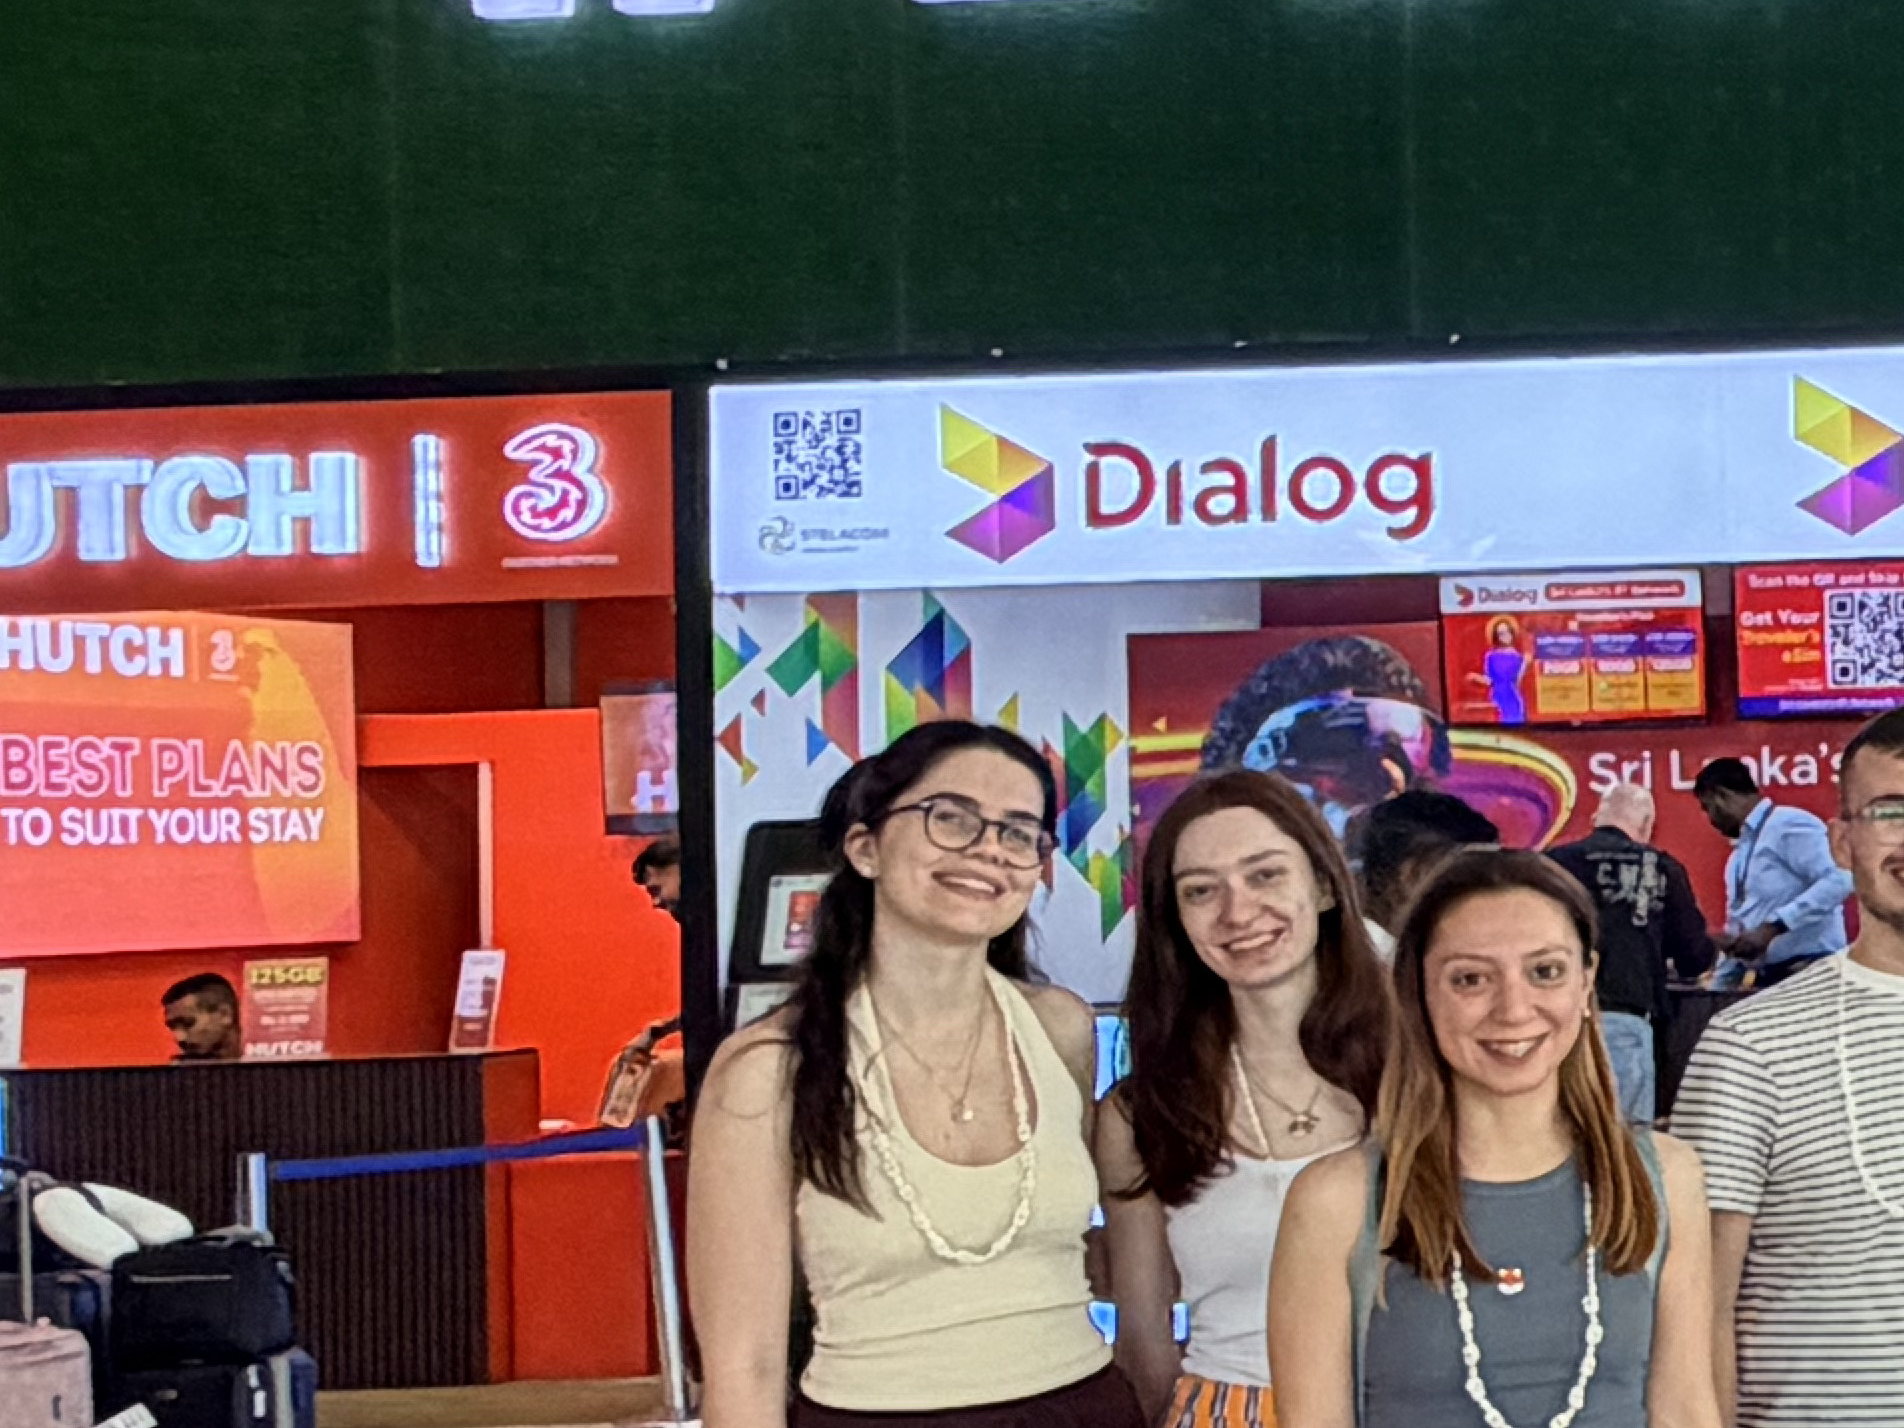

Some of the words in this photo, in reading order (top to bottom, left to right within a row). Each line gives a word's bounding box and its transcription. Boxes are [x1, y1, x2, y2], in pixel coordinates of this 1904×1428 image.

[1083, 433, 1434, 540] Dialog
[0, 616, 185, 678] HUTCH
[0, 733, 141, 798] BEST
[150, 737, 326, 799] PLANS
[1588, 750, 1652, 797] Sri
[0, 808, 53, 846] TO
[60, 808, 144, 846] SUIT
[147, 807, 242, 844] YOUR
[248, 806, 325, 844] STAY
